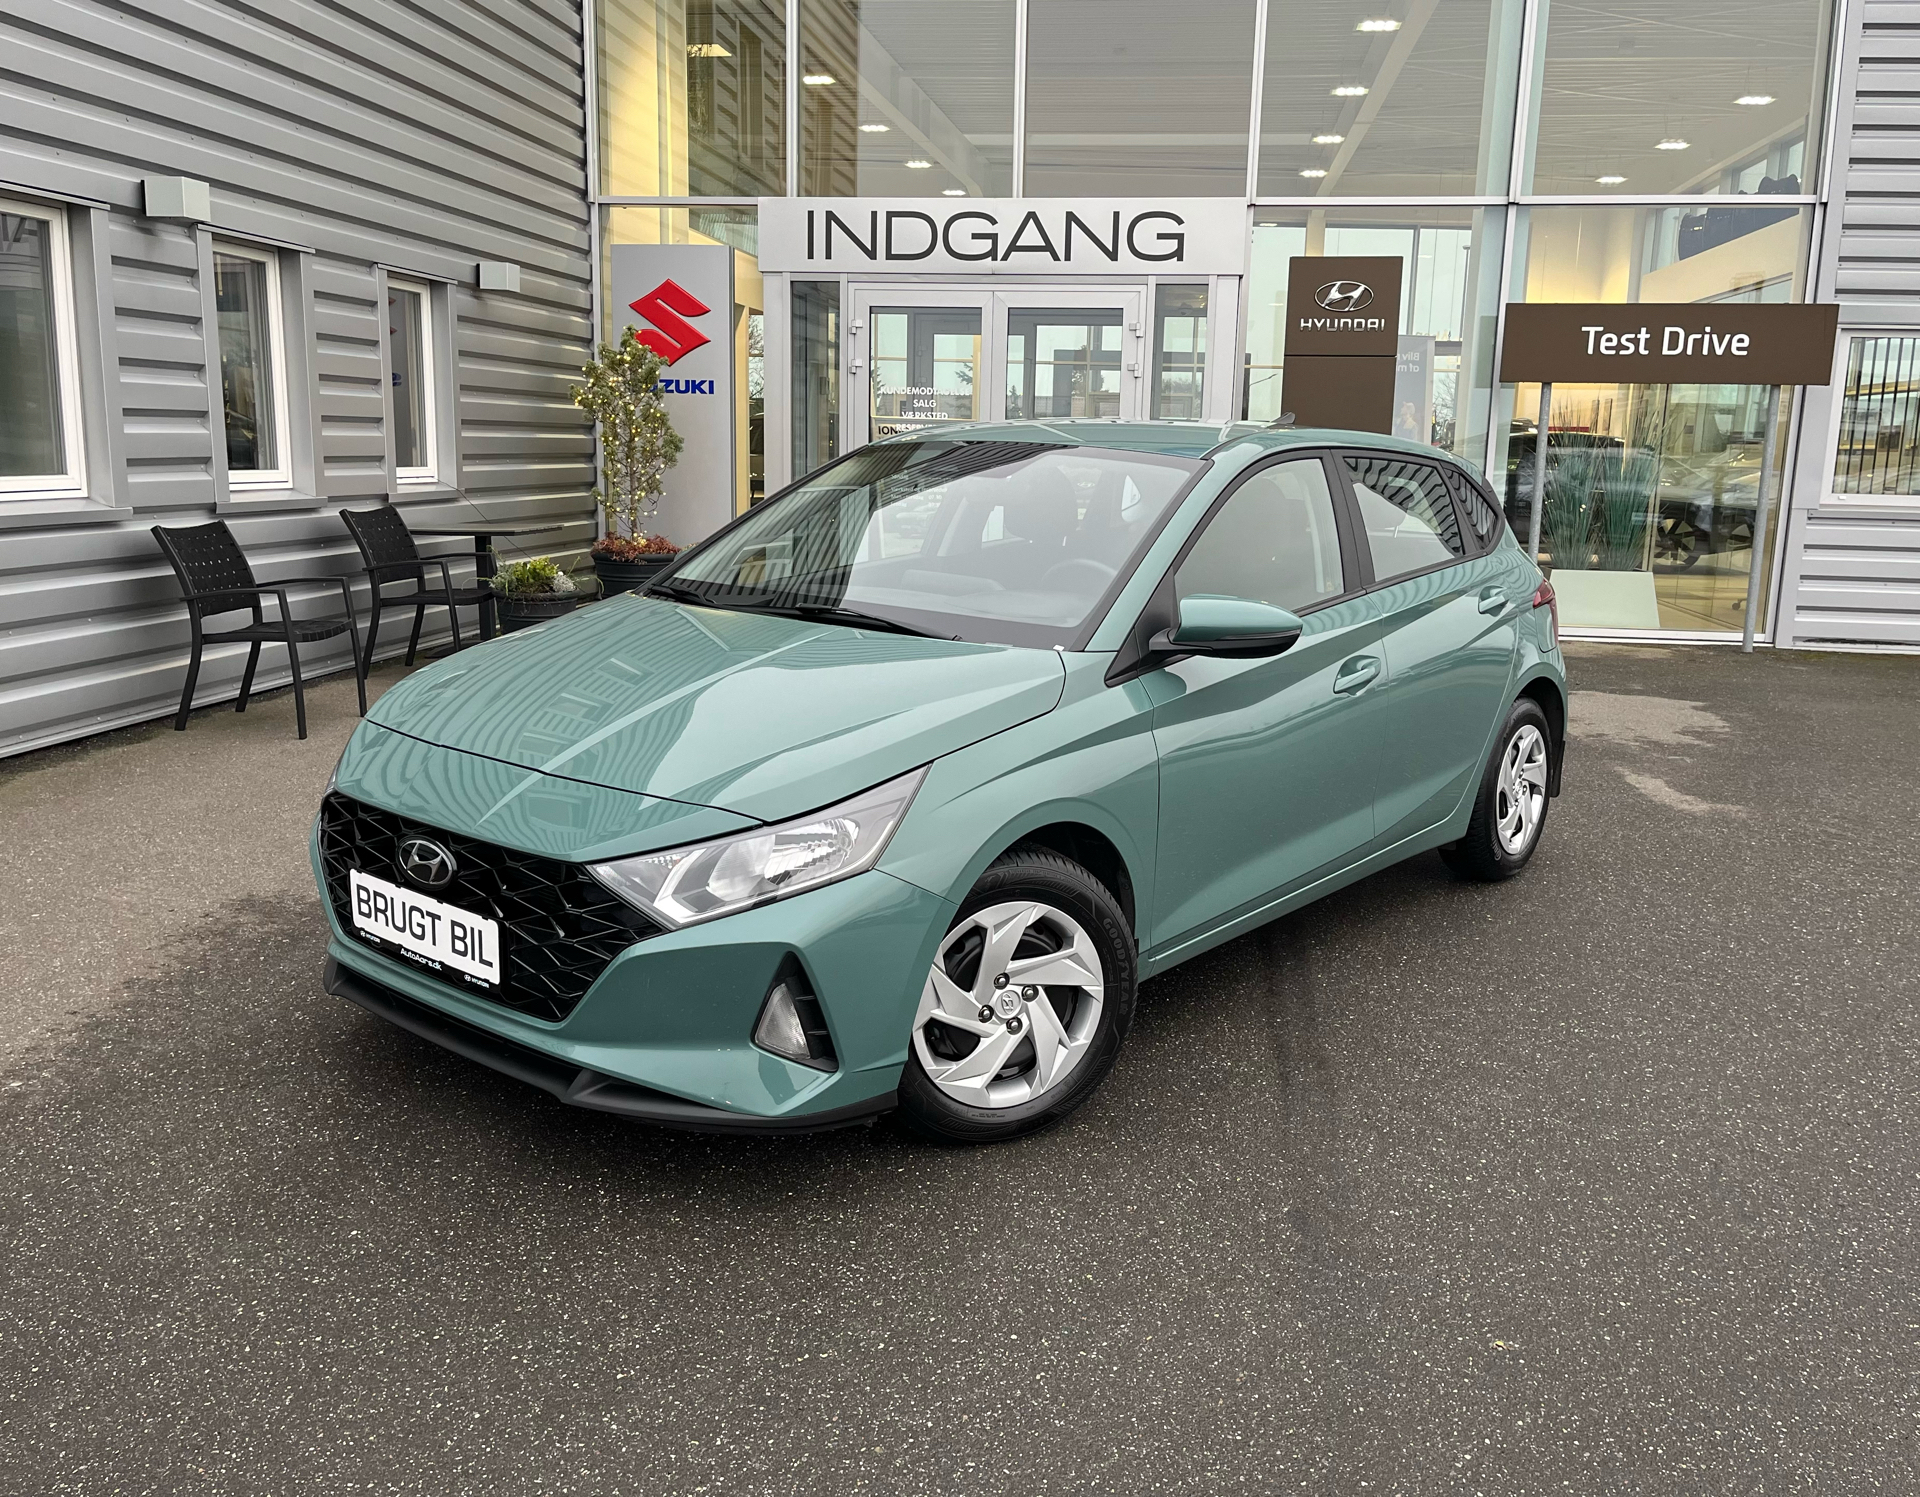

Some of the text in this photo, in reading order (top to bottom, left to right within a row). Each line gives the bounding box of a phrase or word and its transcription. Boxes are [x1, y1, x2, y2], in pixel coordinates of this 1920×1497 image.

[807, 210, 1185, 261] INDGANG
[1300, 318, 1385, 333] HYUNDAI
[1582, 326, 1750, 356] Test Drive
[650, 379, 715, 395] ZUKI
[913, 399, 936, 407] SALG
[356, 884, 493, 968] BRUGT BIL
